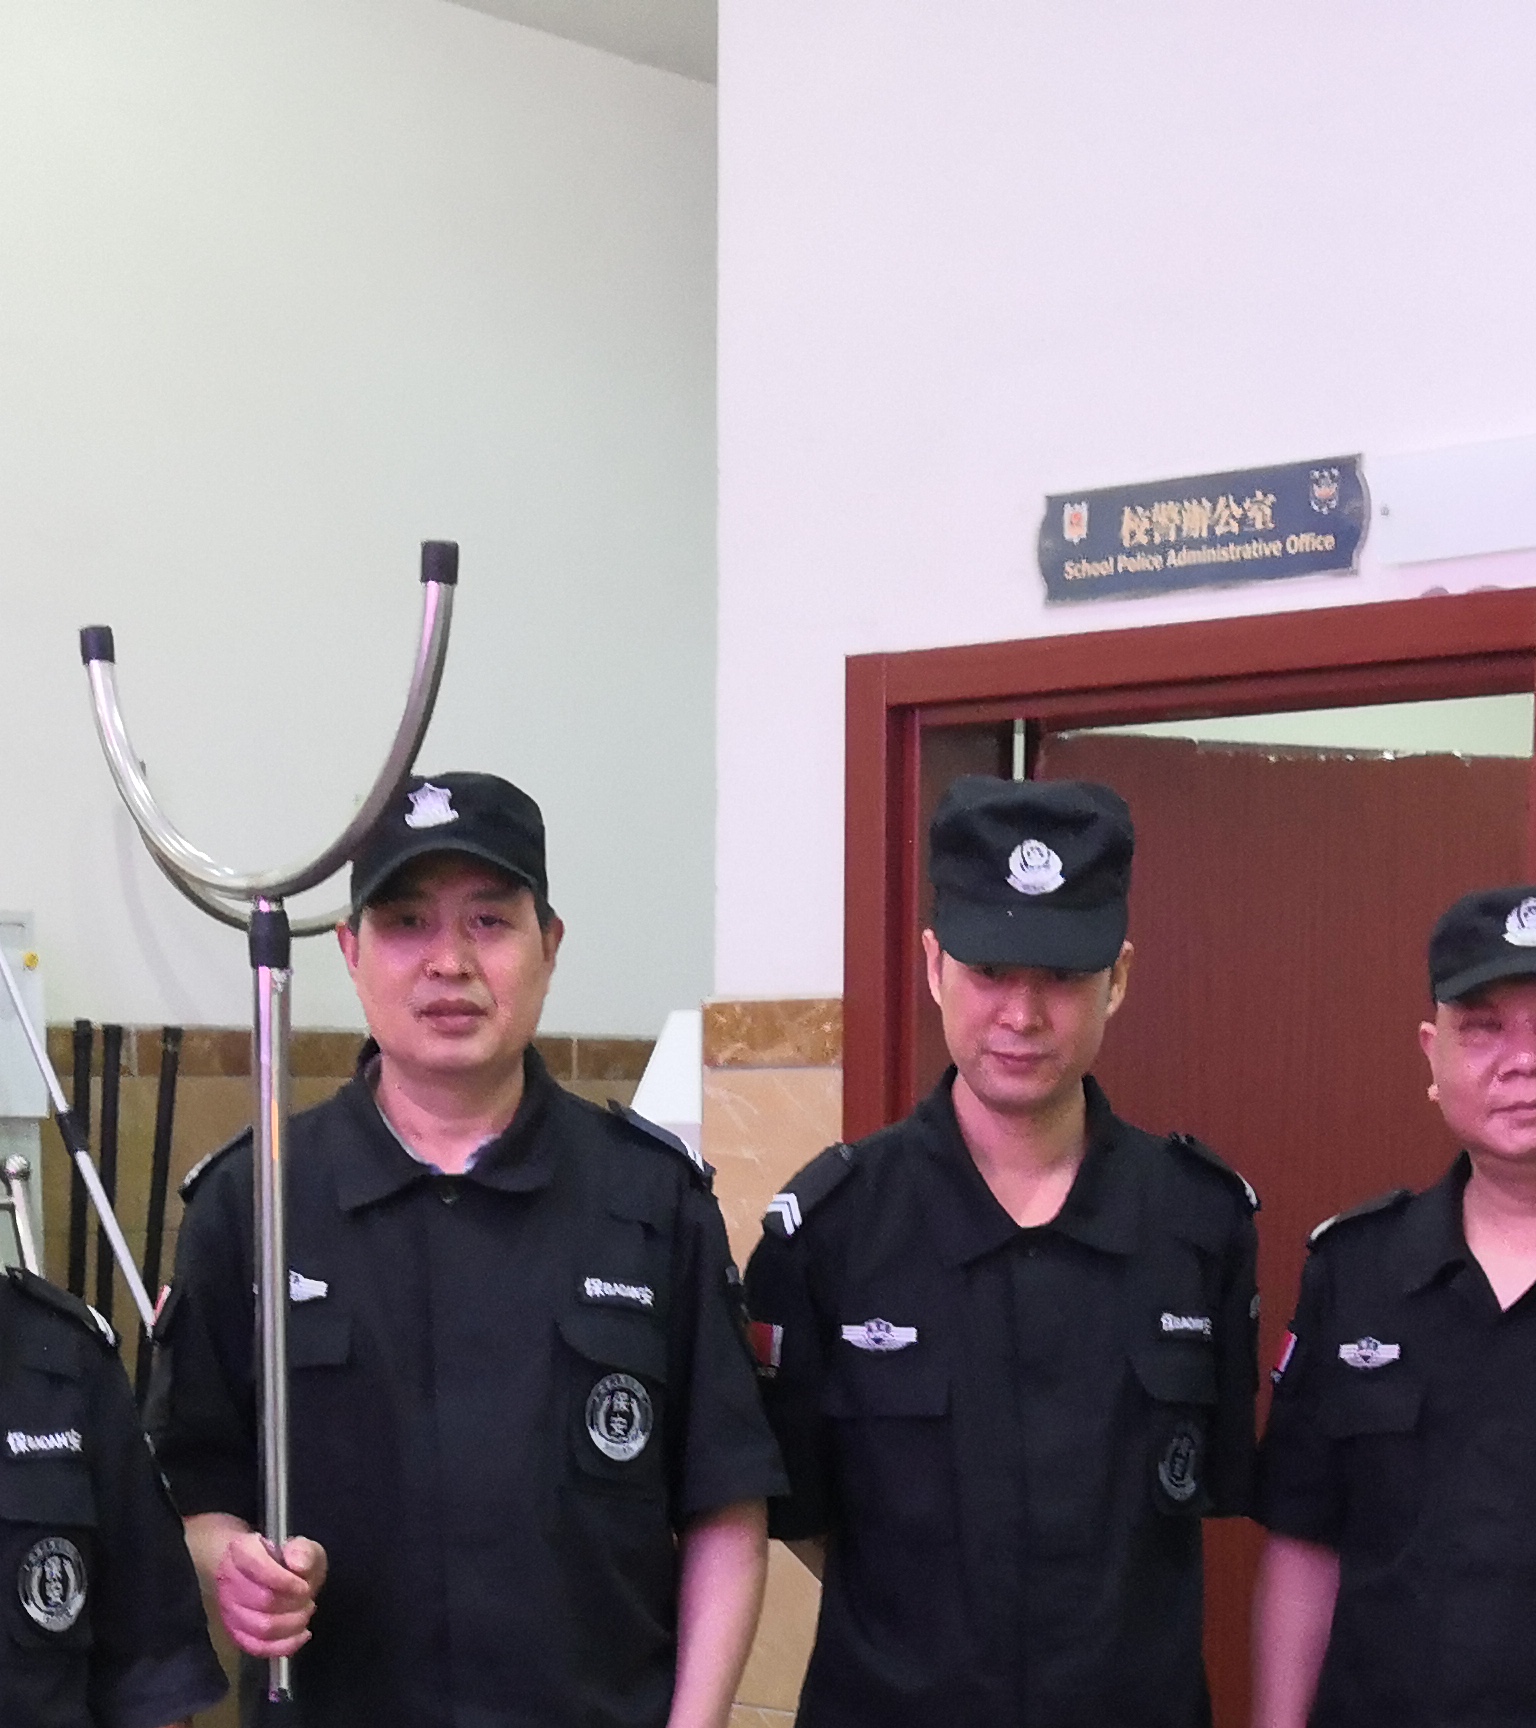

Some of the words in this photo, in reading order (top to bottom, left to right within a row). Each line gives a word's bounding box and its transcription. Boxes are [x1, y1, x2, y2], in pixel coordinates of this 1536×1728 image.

[1064, 556, 1114, 580] School
[1117, 553, 1163, 574] Police
[1166, 540, 1283, 568] Administrative
[1285, 532, 1336, 555] Office
